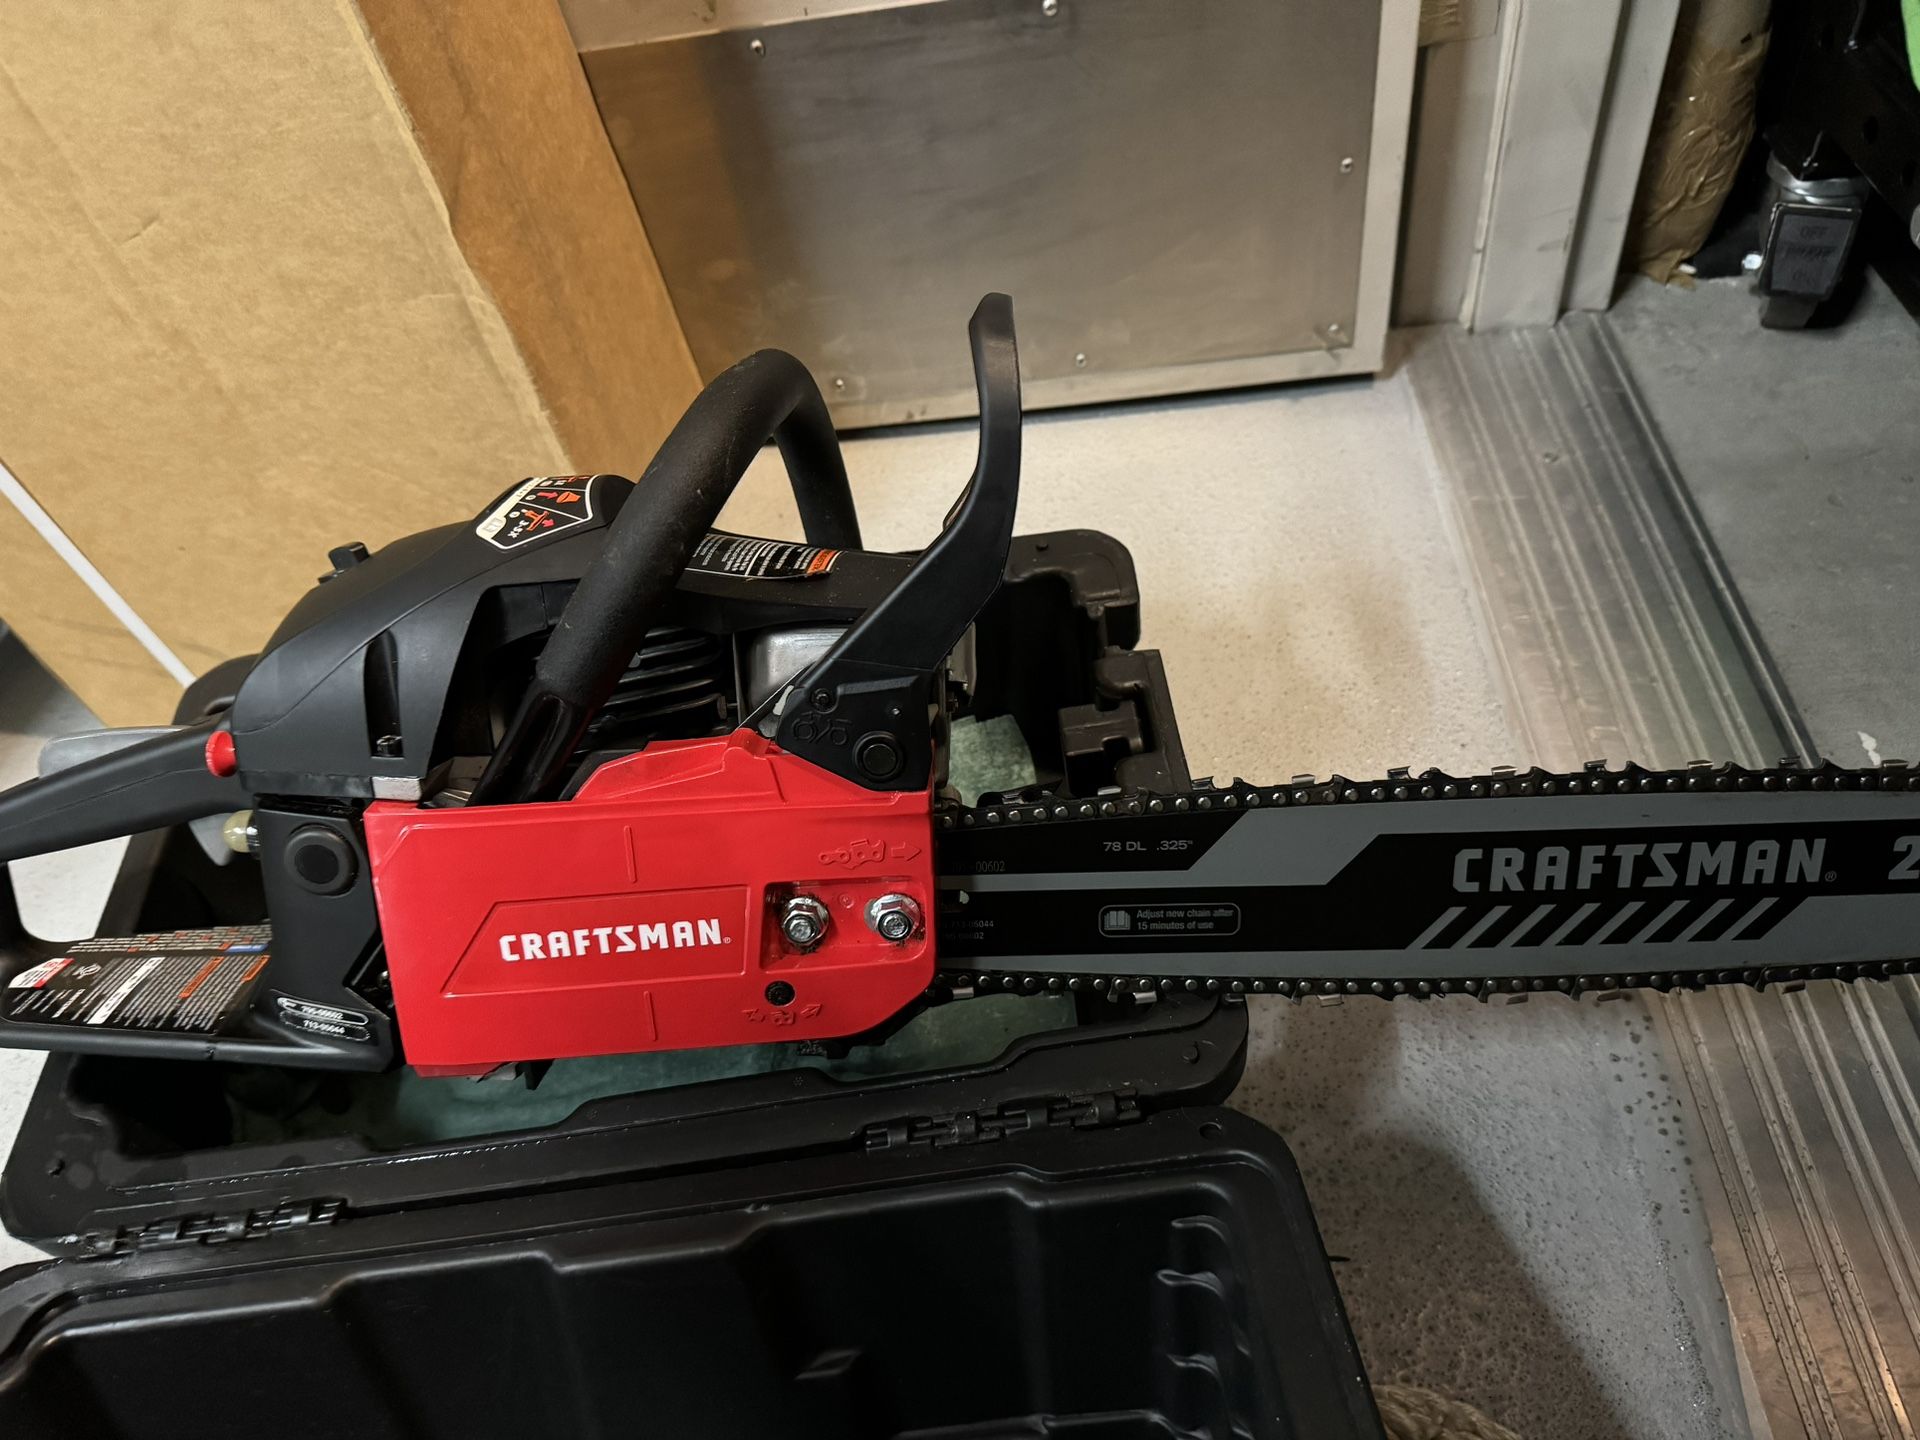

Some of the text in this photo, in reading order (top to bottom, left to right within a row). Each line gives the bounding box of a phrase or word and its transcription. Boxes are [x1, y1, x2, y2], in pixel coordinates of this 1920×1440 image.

[1103, 841, 1122, 852] 78
[1126, 841, 1147, 852] DL
[1136, 909, 1164, 919] Adjust
[1137, 922, 1148, 930] 15
[1150, 921, 1185, 930] minutes
[1187, 921, 1196, 929] of
